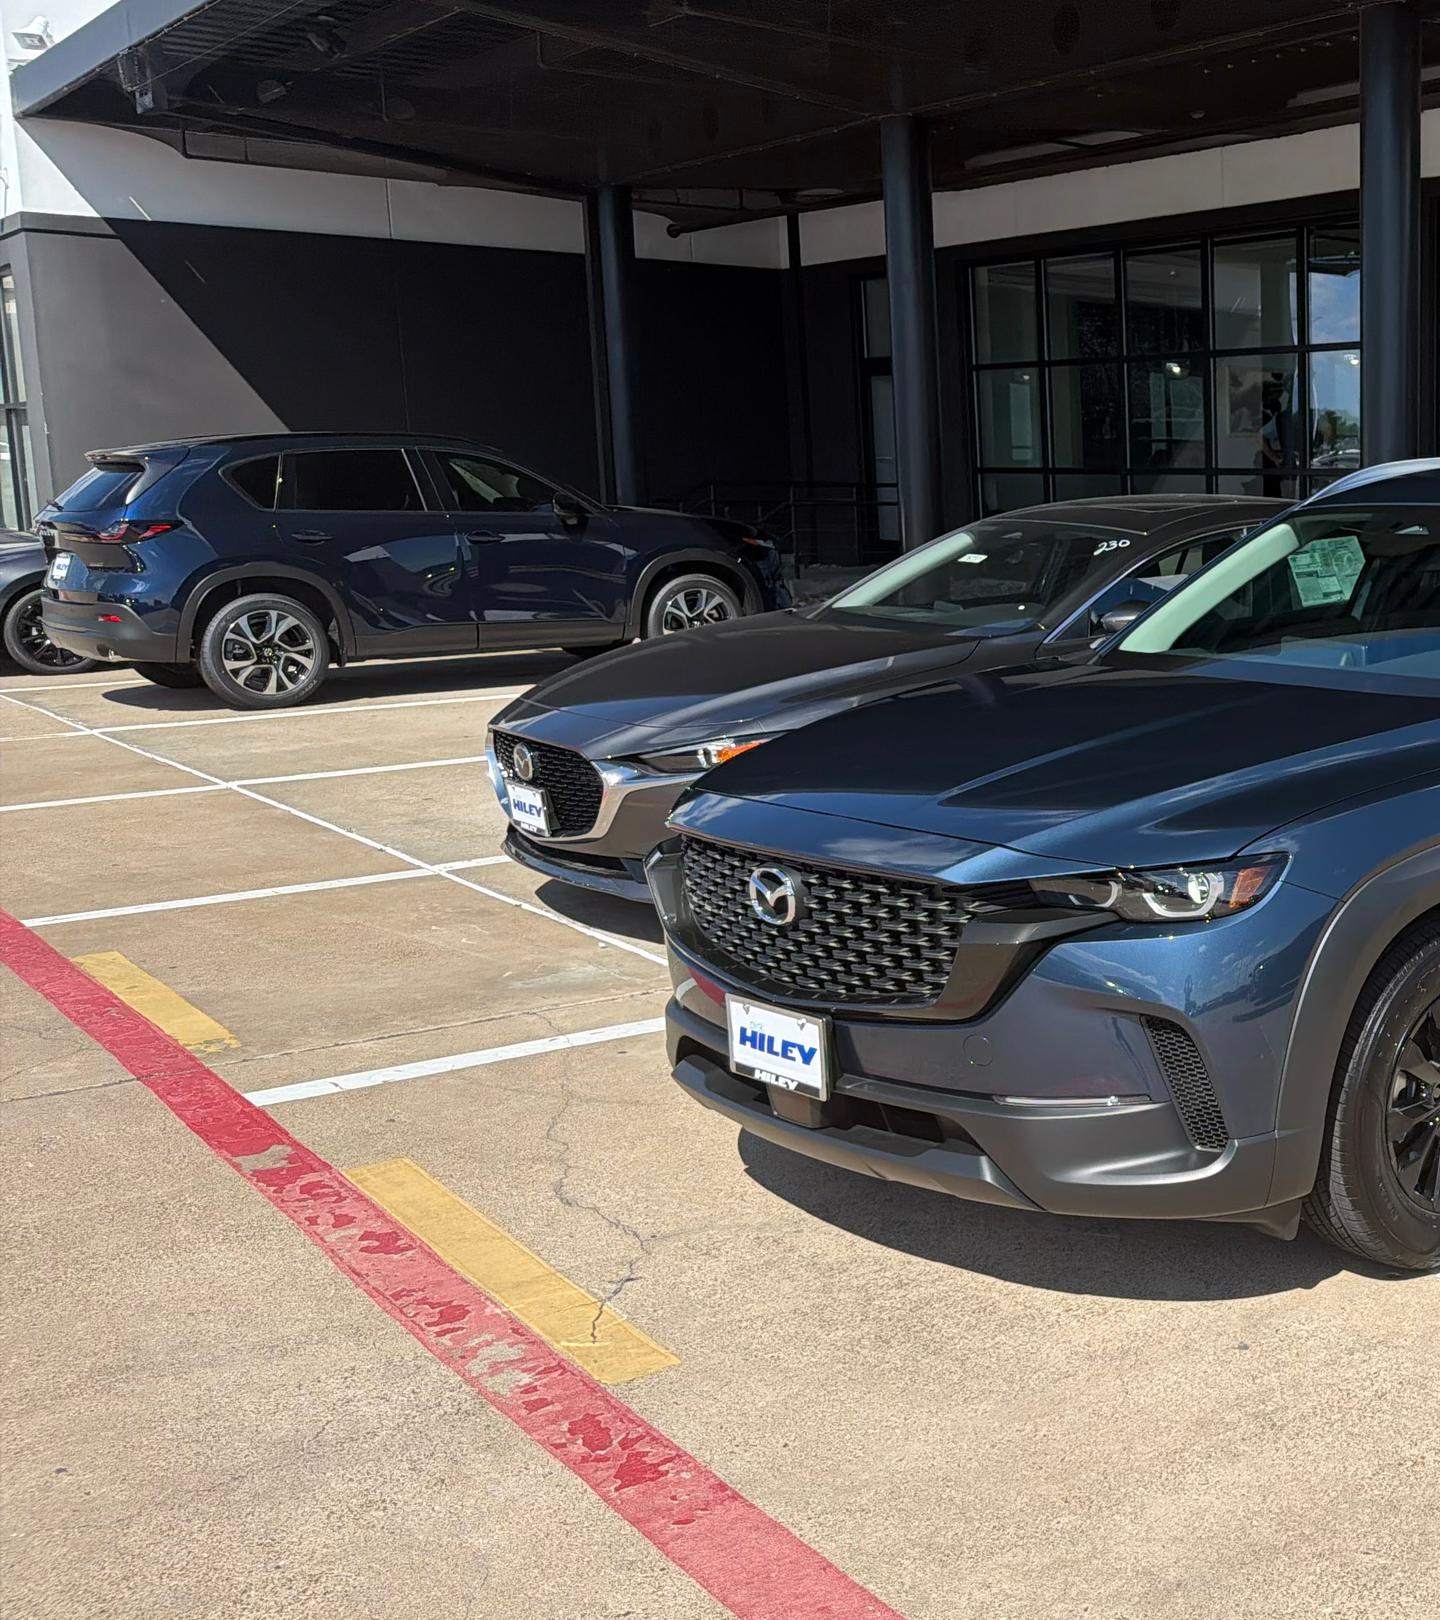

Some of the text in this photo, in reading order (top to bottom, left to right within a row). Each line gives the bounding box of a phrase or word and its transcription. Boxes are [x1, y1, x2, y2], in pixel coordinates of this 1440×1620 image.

[1093, 539, 1131, 556] 230
[513, 798, 542, 818] HILEY
[739, 1026, 818, 1066] HILEY
[754, 1068, 798, 1091] HILEY
